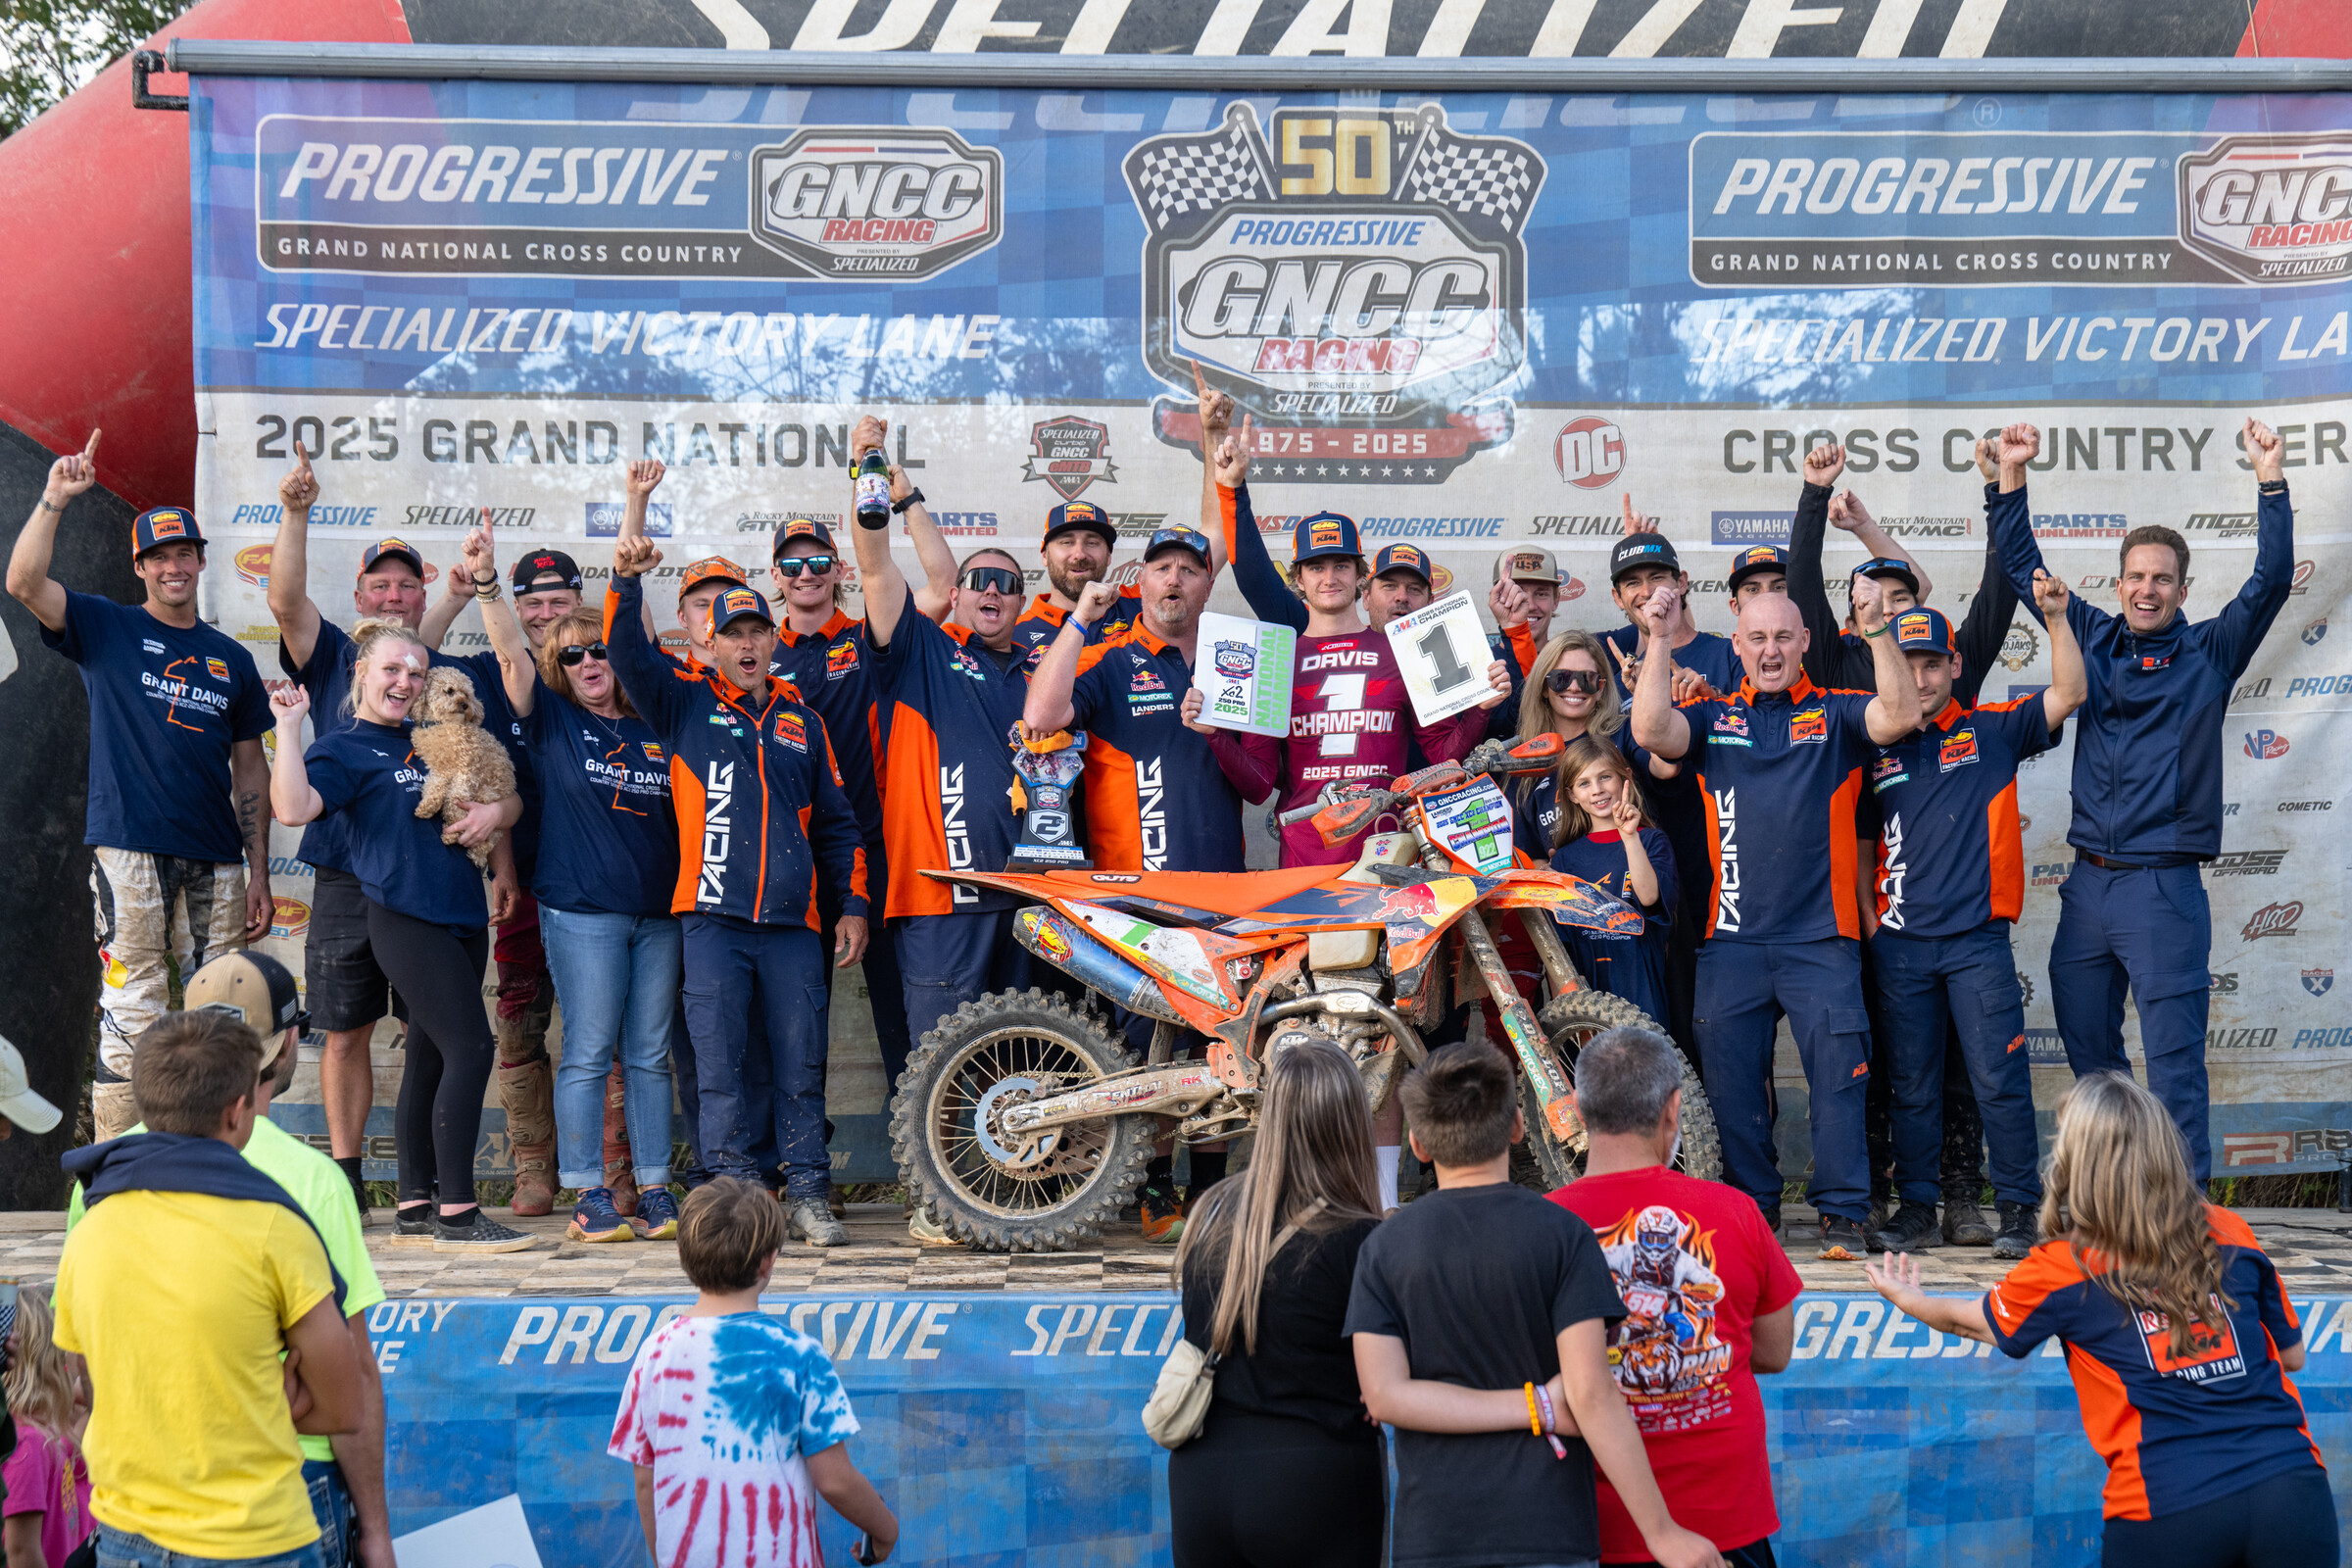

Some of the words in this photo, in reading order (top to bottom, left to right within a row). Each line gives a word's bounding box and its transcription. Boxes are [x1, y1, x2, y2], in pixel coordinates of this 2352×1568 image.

[1281, 119, 1392, 196] 50
[1395, 121, 1415, 135] TH
[280, 141, 728, 207] PROGRESSIVE
[772, 163, 983, 220] GNCC
[1712, 157, 2156, 215] PROGRESSIVE
[2199, 168, 2352, 224] GNC
[821, 219, 938, 243] RACING
[1230, 220, 1426, 247] PROGRESSIVE
[277, 238, 368, 259] GRAND
[381, 241, 512, 262] NATIONAL
[525, 242, 608, 263] CROSS
[621, 244, 743, 264] COUNTRY
[830, 256, 919, 272] SPECIALIZED
[1710, 253, 1800, 272] GRAND
[1812, 252, 1943, 271] NATIONAL
[1956, 252, 2038, 271] CROSS
[2051, 252, 2173, 270] COUNTRY
[2257, 256, 2348, 277] SPECIALIZED
[1182, 260, 1485, 337] GNCC
[255, 303, 575, 354] SPECIALIZED
[591, 309, 825, 357] VICTORY
[840, 313, 1001, 361] LANE
[1690, 317, 2008, 363] SPECIALIZED
[2024, 317, 2273, 364] VICTORY
[2278, 311, 2352, 362] LA
[1255, 338, 1422, 373] RACING
[1269, 393, 1398, 415] SPECIALIZED
[257, 414, 399, 462] 2025
[422, 417, 619, 466] GRAND
[643, 421, 926, 469] NATIONL
[1040, 428, 1101, 440] SPECIALIZED
[1250, 433, 1313, 454] 975
[1352, 432, 1428, 454] 2025
[1050, 446, 1090, 459] GNCC
[1561, 422, 1623, 483] DC
[1941, 426, 2215, 473] CUNTRY
[231, 503, 378, 526] PROESSIVE
[609, 510, 664, 525] YAHA
[903, 512, 999, 527] ARTS
[1880, 515, 1913, 525] ROCKY
[1913, 515, 1966, 525] MOUNTAIN
[2033, 513, 2128, 529] PARTS
[1359, 516, 1505, 537] PROGRESSIVE
[1734, 517, 1790, 534] YAMAHA
[2034, 528, 2128, 538] UNLIMITED
[1617, 544, 1663, 562] CLUBMX
[1417, 609, 1435, 620] 2025
[1434, 595, 1467, 614] NATIONAL
[1419, 599, 1469, 624] CHAMPION
[1393, 616, 1418, 636] AMA
[1903, 626, 1929, 638] KTM
[1218, 654, 1251, 666] GNCC
[1300, 651, 1380, 673] DAVIS
[1416, 620, 1475, 697] 1
[1130, 682, 1149, 692] Red
[1148, 680, 1166, 690] Bull
[1254, 627, 1277, 728] NATIONAL
[1270, 628, 1294, 730] CHAMPION
[141, 670, 190, 697] GRANT
[191, 686, 228, 710] DAVIS
[1139, 692, 1172, 702] MOTOREX
[1131, 703, 1175, 717] LANDERS
[1214, 703, 1249, 716] 2025
[780, 725, 804, 739] KTM
[1290, 710, 1396, 737] CHAMPION
[1713, 721, 1731, 732] Red
[1731, 724, 1749, 737] Bull
[1796, 723, 1822, 736] KTM
[1718, 736, 1751, 747] MOTOREX
[2244, 728, 2276, 760] VP
[1945, 745, 1971, 760] KTM
[585, 758, 631, 782] GRANT
[634, 770, 672, 787] DAVIS
[1301, 766, 1342, 780] 2025
[1343, 764, 1389, 778] GNCC
[1886, 762, 1903, 775] Bull
[1878, 773, 1907, 789] MOTOREX
[2277, 800, 2333, 812] COMETIC
[1035, 814, 1061, 836] 2
[1479, 842, 1496, 858] 922
[1487, 859, 1511, 871] MOTOREX
[2212, 865, 2278, 878] OFFROAD
[1155, 902, 1186, 915] DAVIS
[1605, 910, 1642, 930] KTM
[1388, 926, 1405, 939] Red
[1405, 927, 1425, 939] Bull
[2309, 976, 2327, 993] X
[1279, 1034, 1309, 1046] KTM
[1181, 1076, 1202, 1087] RK
[1678, 1343, 1732, 1381] RUN
[2211, 1356, 2241, 1375] TEAM
